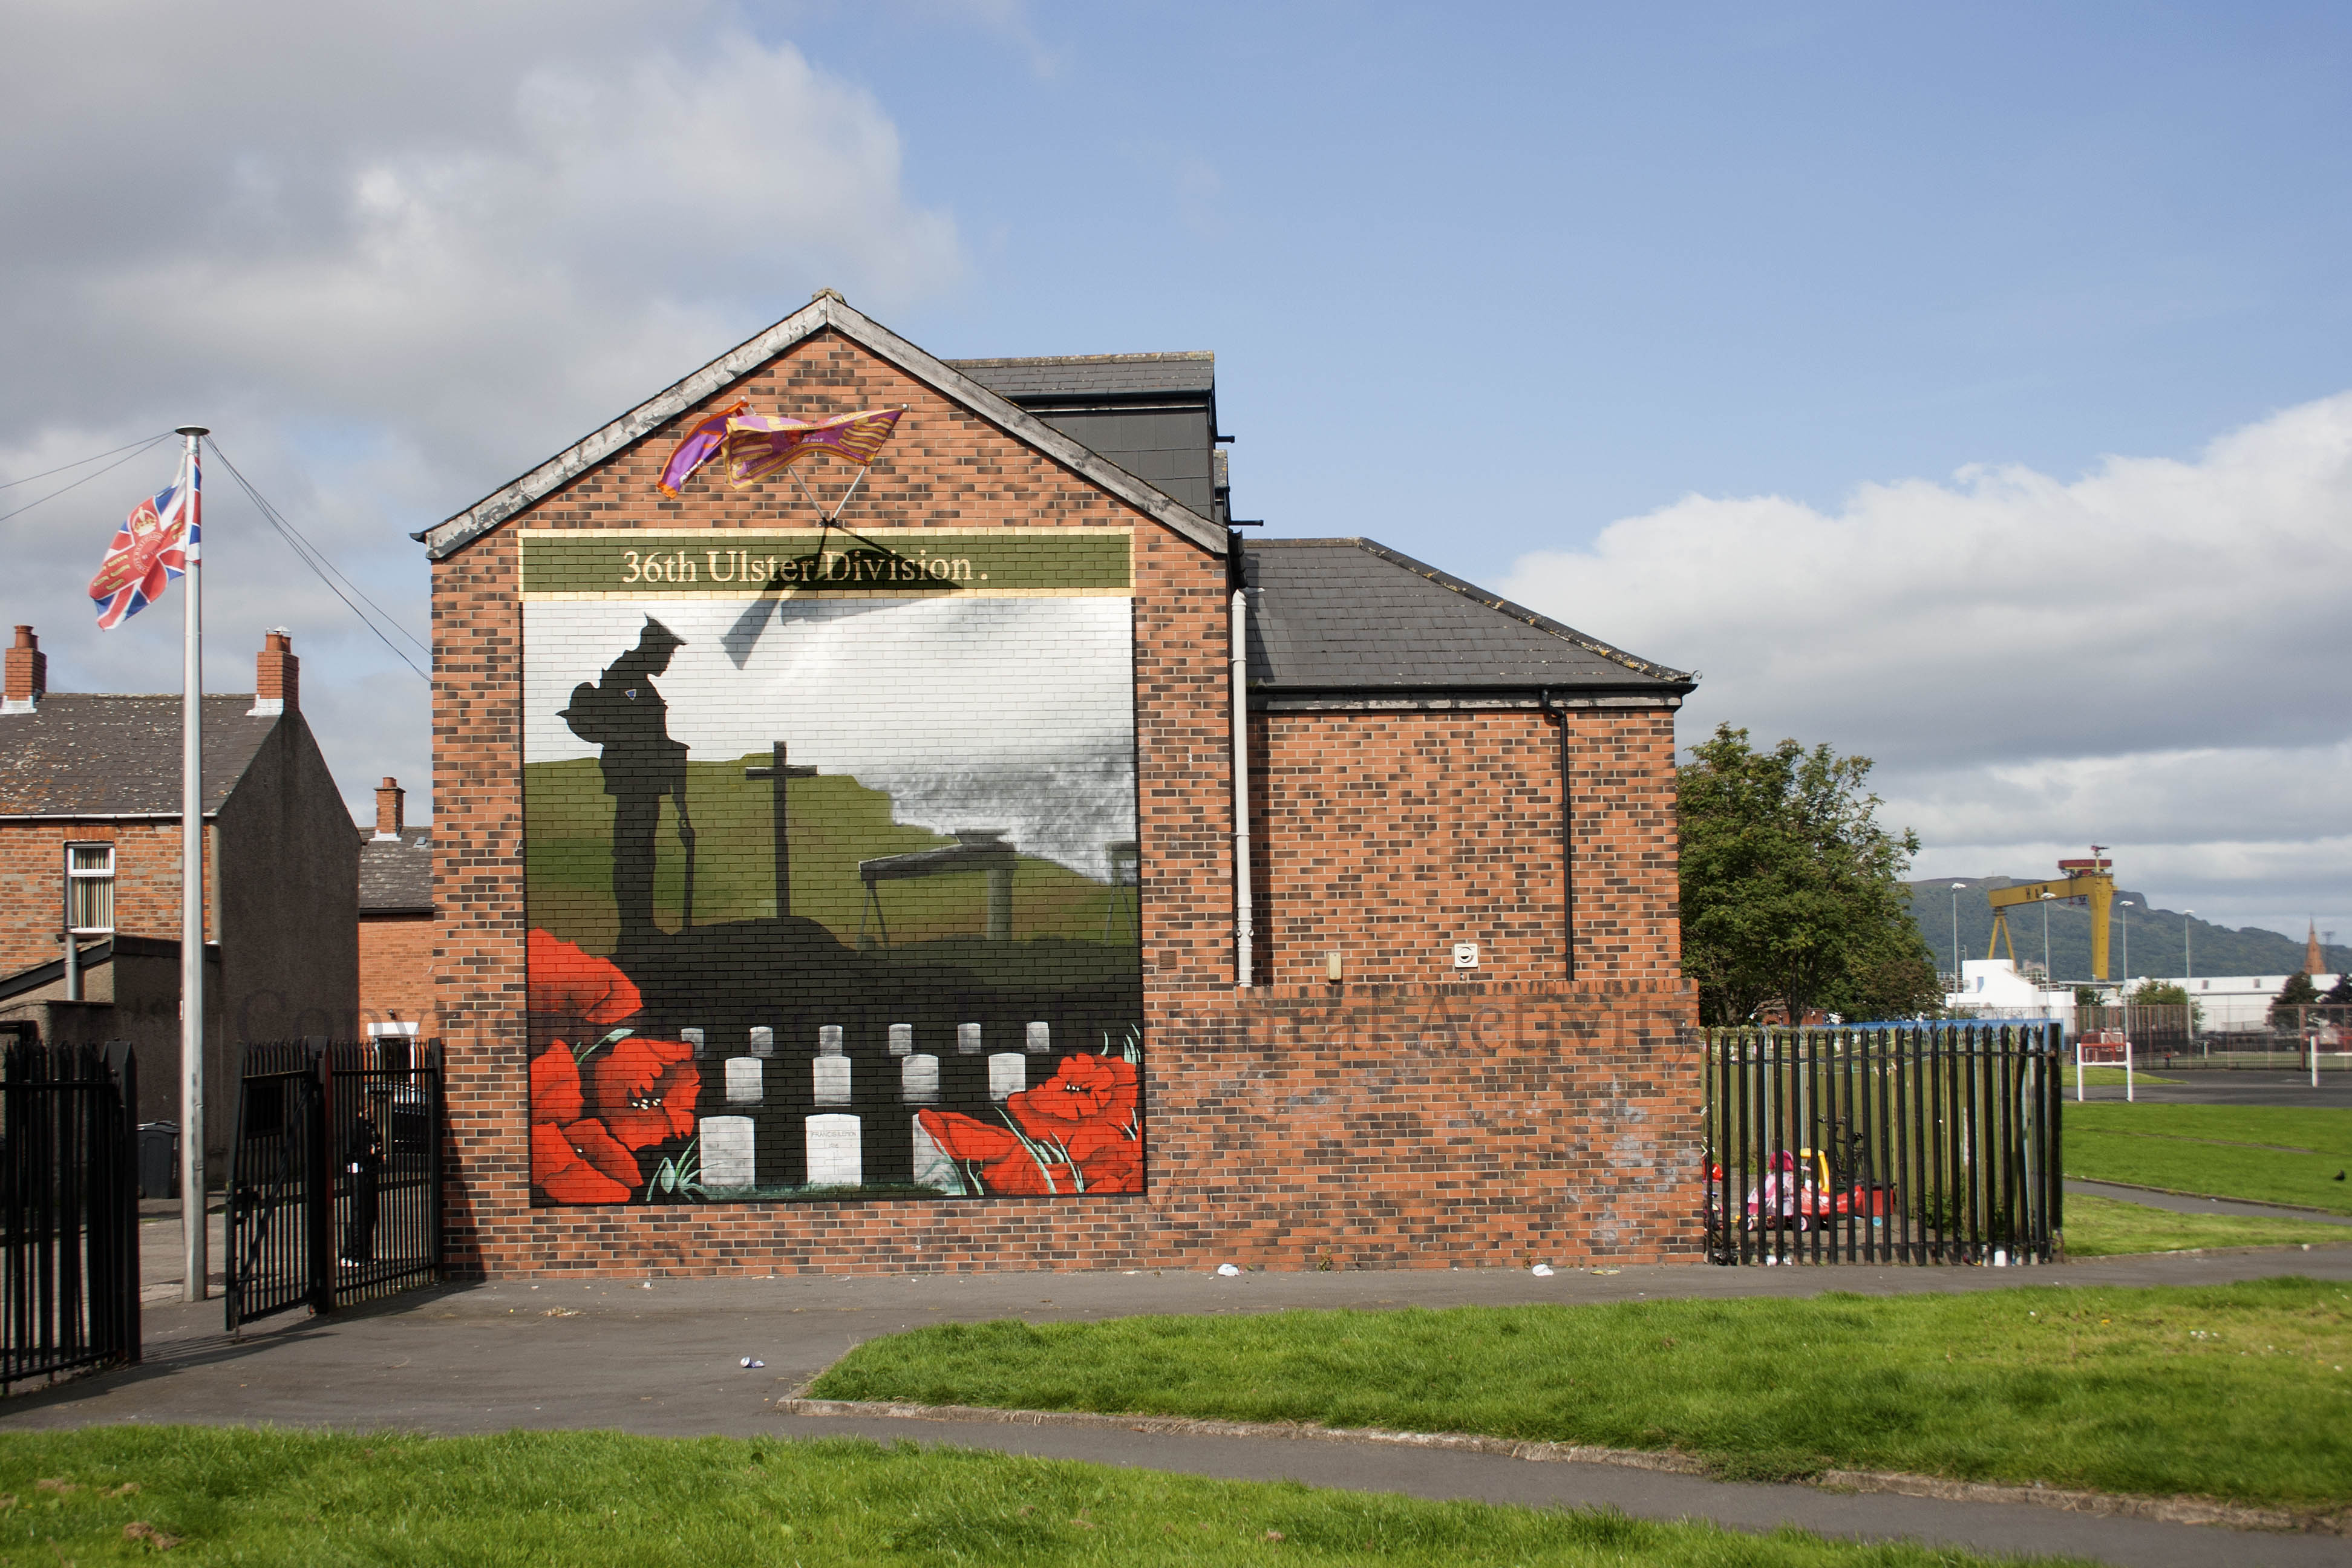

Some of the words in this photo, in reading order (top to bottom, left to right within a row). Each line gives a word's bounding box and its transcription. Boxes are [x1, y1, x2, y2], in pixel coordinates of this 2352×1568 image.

[622, 550, 698, 583] 36th
[706, 550, 814, 582] Ulster
[823, 549, 988, 581] Division.
